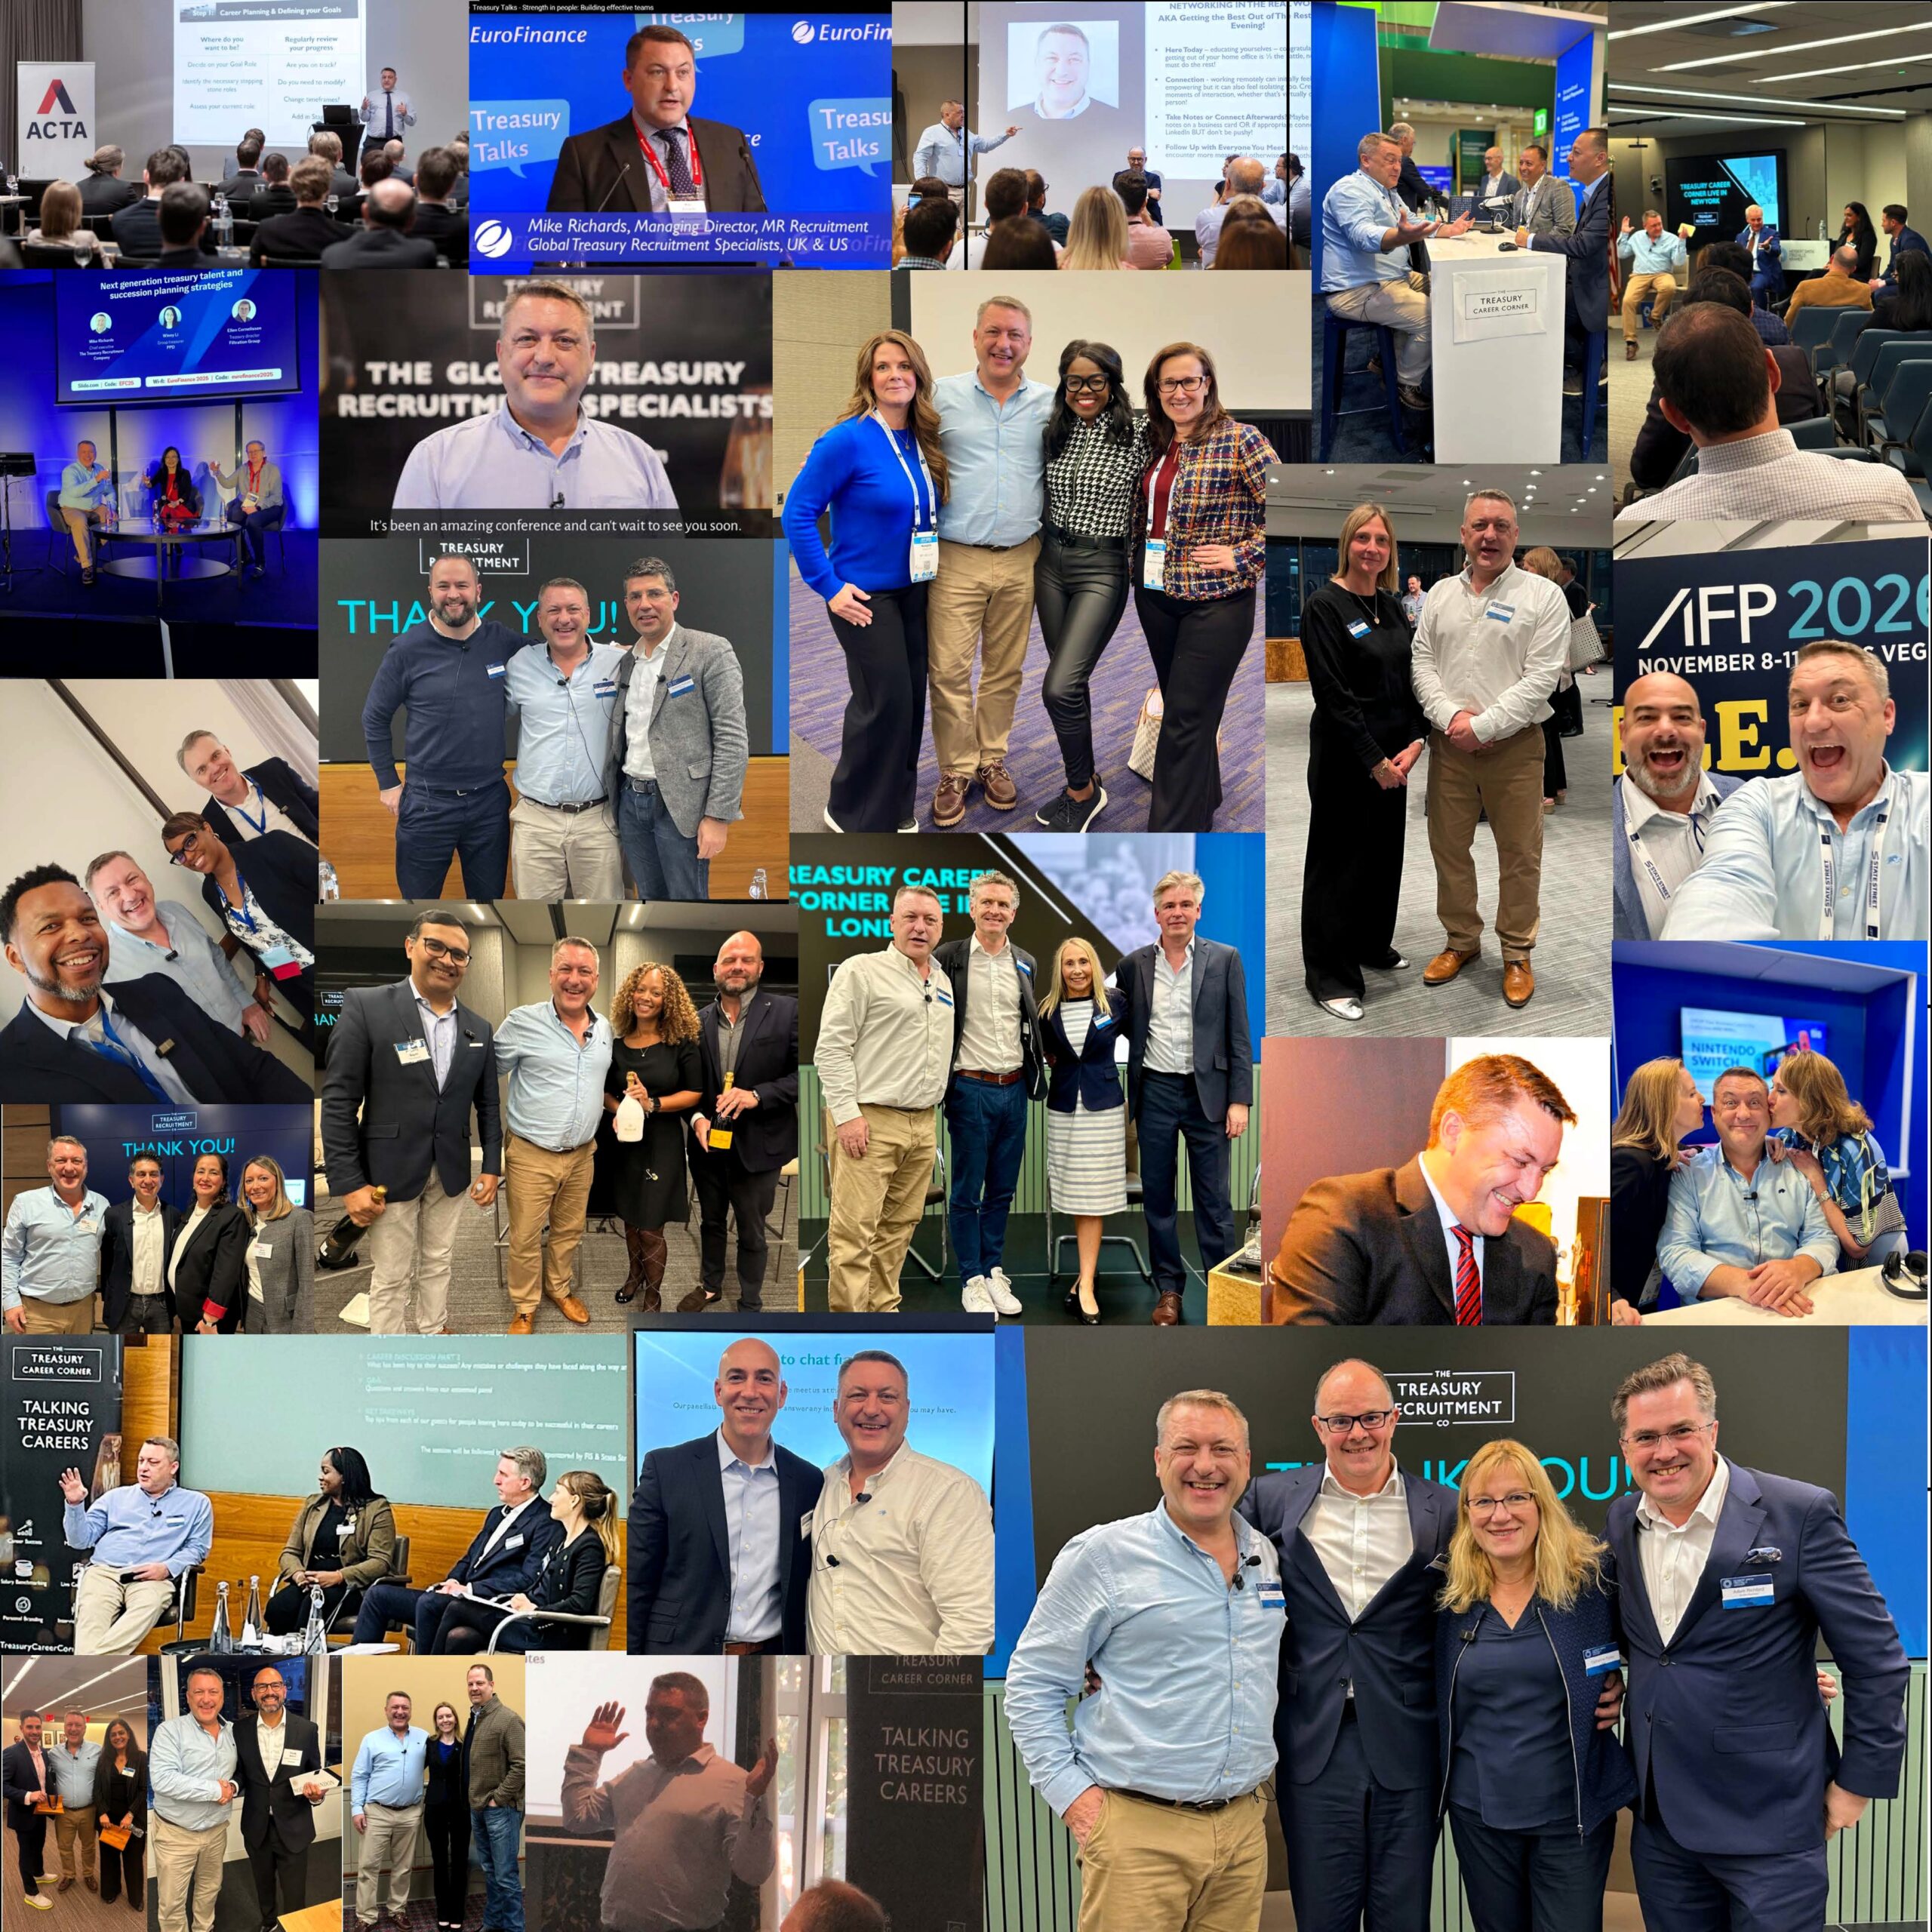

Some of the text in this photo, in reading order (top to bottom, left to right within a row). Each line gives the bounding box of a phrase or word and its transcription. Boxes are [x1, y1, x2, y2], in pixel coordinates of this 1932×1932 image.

[278, 7, 304, 15] Defining
[470, 26, 587, 43] EuroFinance
[819, 23, 892, 41] EuroFin
[1231, 22, 1265, 30] Evening!
[471, 110, 561, 131] Treasury
[820, 109, 892, 129] Treasu
[26, 122, 88, 139] ACTA
[474, 140, 528, 162] Talks
[823, 138, 879, 162] Talks
[100, 269, 243, 290] Next generation treasury talent and
[109, 281, 232, 300] succession planning strategies
[1481, 295, 1522, 304] TREASURY
[365, 361, 432, 385] THE
[586, 361, 745, 385] TREASURY
[338, 394, 773, 417] RECRUITM SPECIALISTS
[440, 543, 504, 553] TREASURY
[1638, 583, 1777, 649] AFP
[1638, 652, 1755, 676] NOVEMBER
[1651, 866, 1671, 899] STATE STREET
[1691, 1042, 1755, 1056] NINTENDO
[1692, 1057, 1740, 1067] SWITCH
[122, 1138, 235, 1156] THANK YOU!
[32, 1354, 84, 1364] TREASURY
[781, 1355, 795, 1365] to
[800, 1353, 829, 1365] chat
[1397, 1381, 1482, 1397] TREASURY
[23, 1401, 89, 1415] TALKING
[1396, 1401, 1503, 1417] ECRUITMENT
[17, 1417, 94, 1432] TREASURY
[22, 1435, 88, 1451] CAREERS
[1539, 1456, 1633, 1500] OU!
[894, 1655, 961, 1667] TREASURY
[881, 1674, 973, 1684] CAREER CORNER
[881, 1727, 968, 1748] TALKING
[874, 1753, 976, 1777] TREASURY
[880, 1781, 967, 1804] CAREERS
